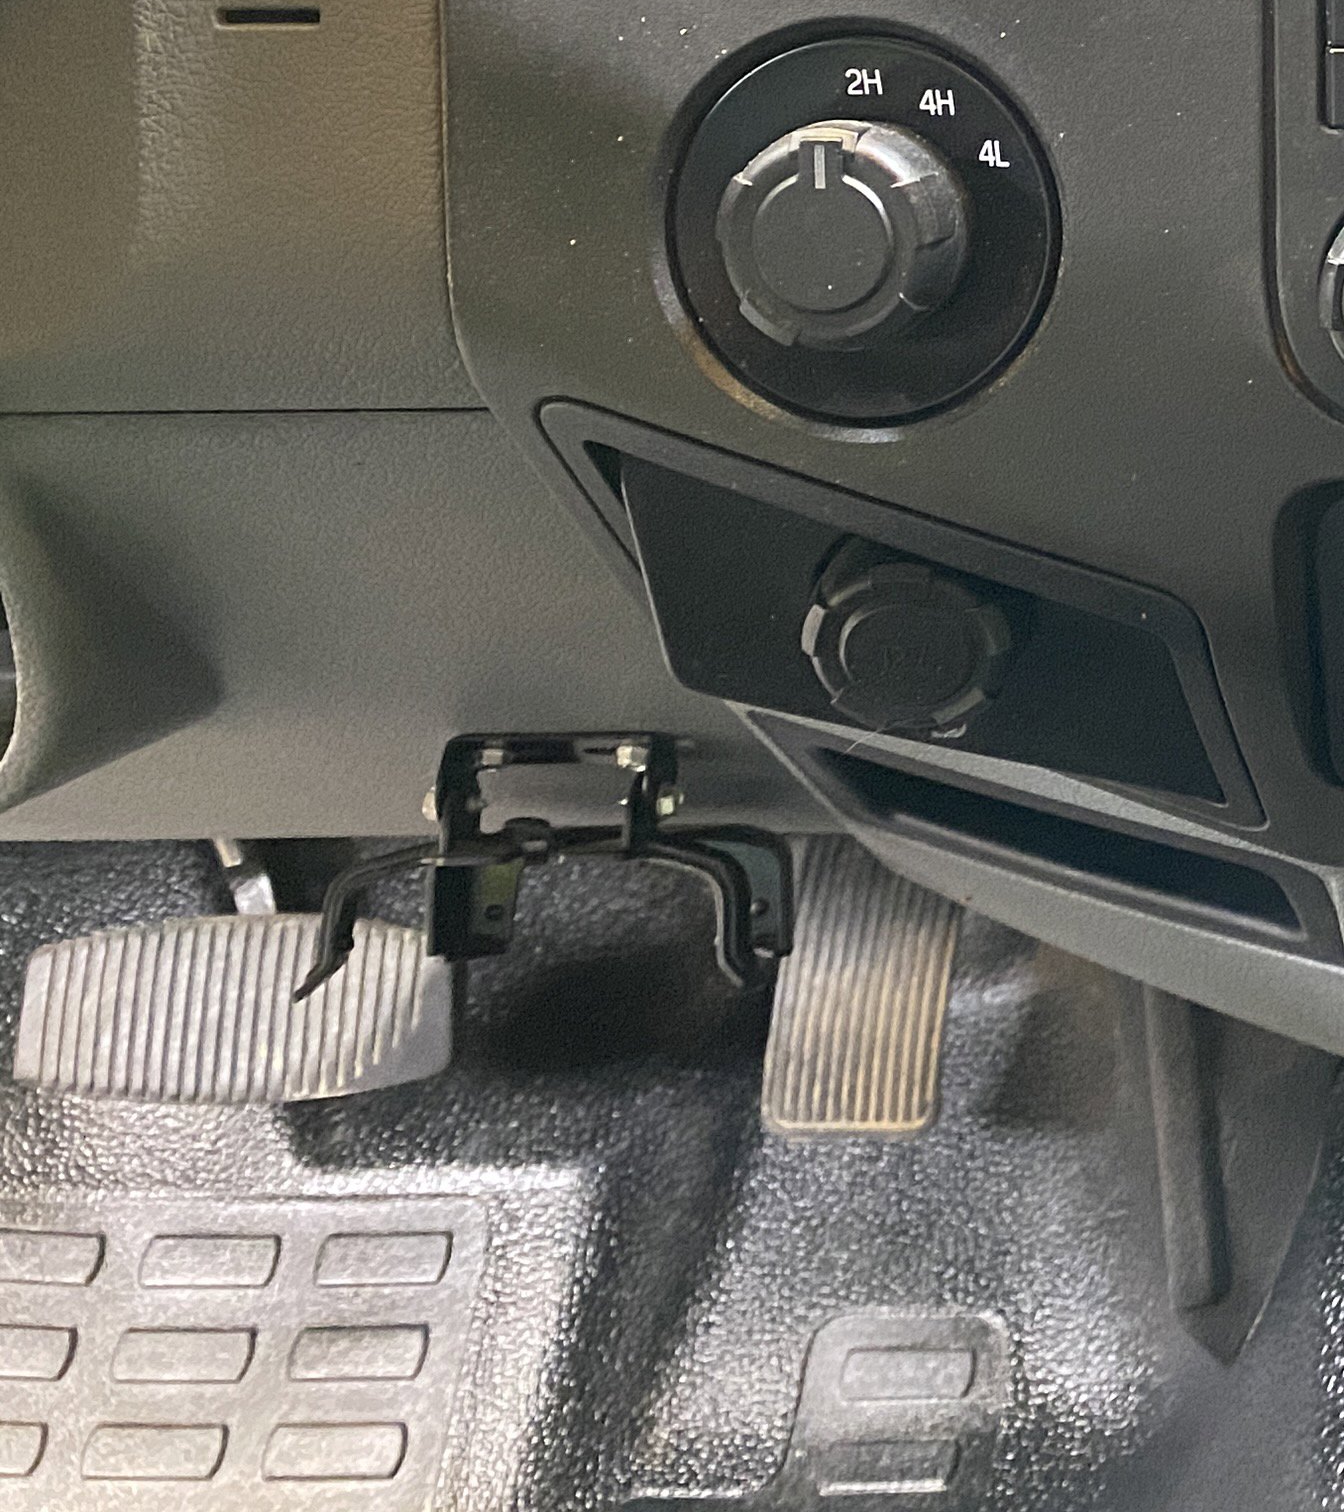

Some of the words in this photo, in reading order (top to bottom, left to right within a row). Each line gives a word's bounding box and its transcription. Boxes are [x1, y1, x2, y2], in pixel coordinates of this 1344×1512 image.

[844, 68, 883, 96] 2H
[918, 88, 956, 116] 4H
[978, 139, 1011, 168] 4L
